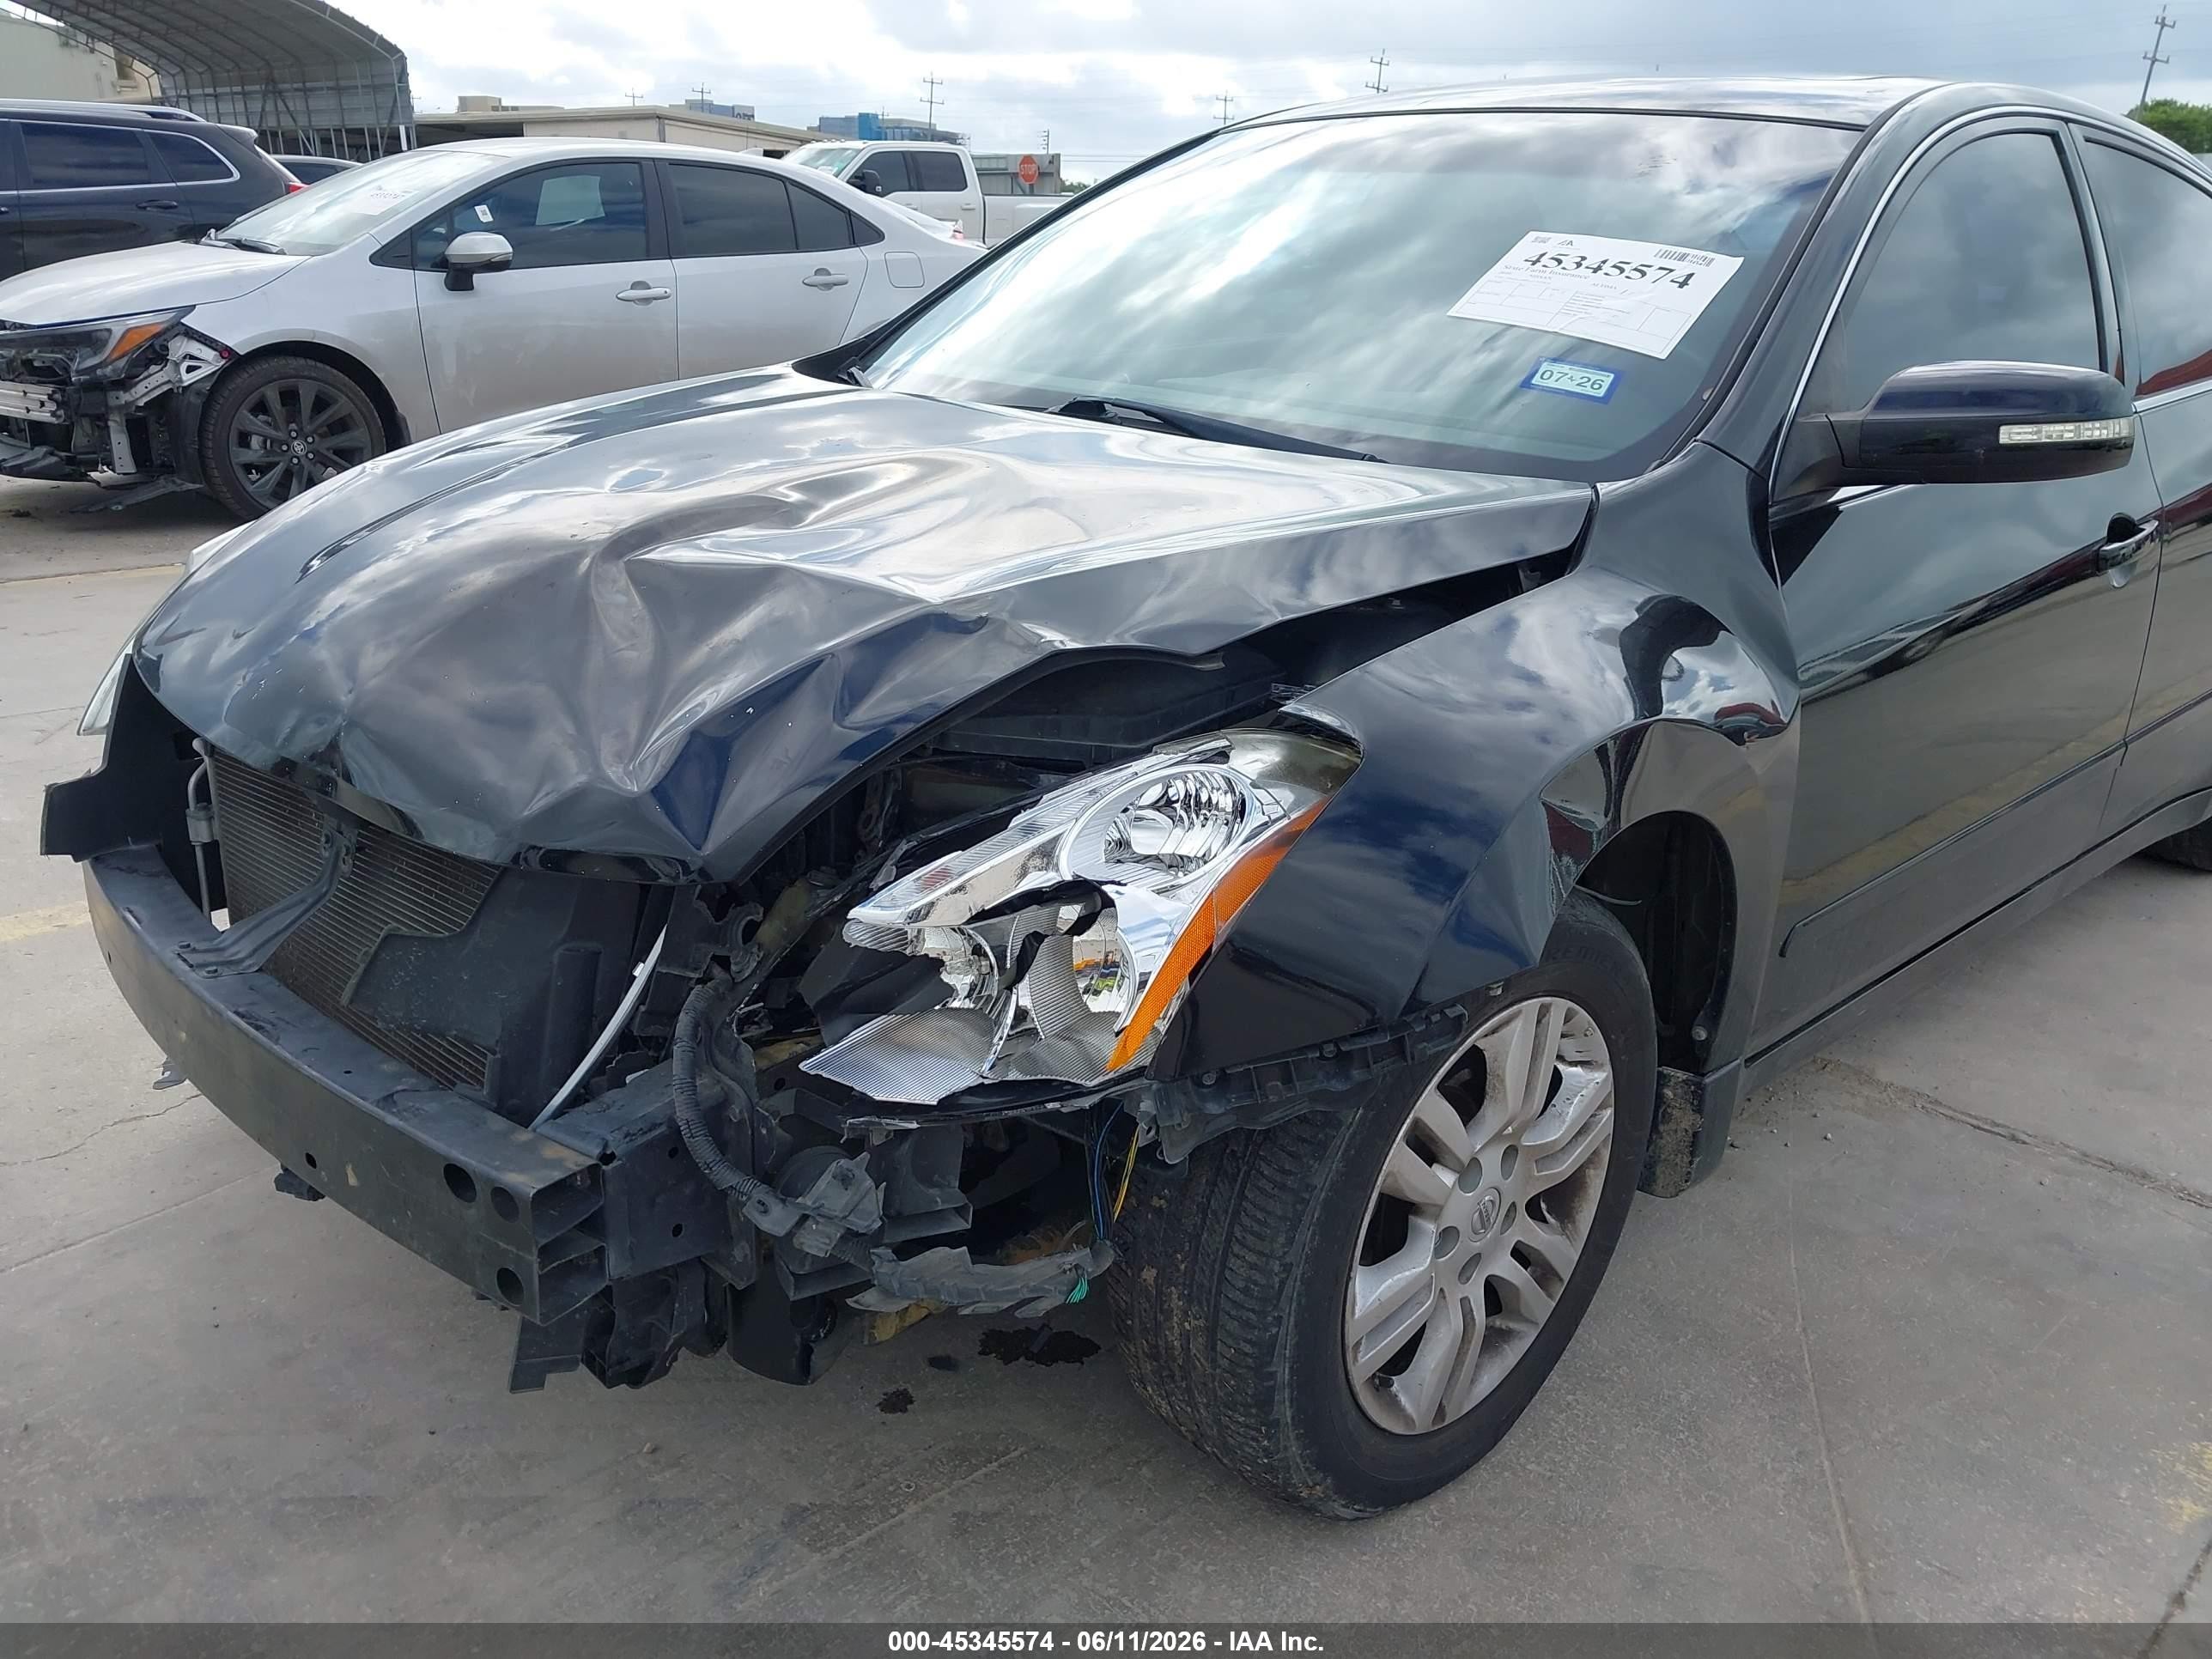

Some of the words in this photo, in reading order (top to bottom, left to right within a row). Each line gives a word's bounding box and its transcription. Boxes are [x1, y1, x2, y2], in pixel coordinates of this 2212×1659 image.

[1020, 164, 1036, 175] STOP
[1523, 252, 1696, 289] 45345574
[1525, 266, 1547, 275] Farm
[1548, 269, 1590, 281] Insurance
